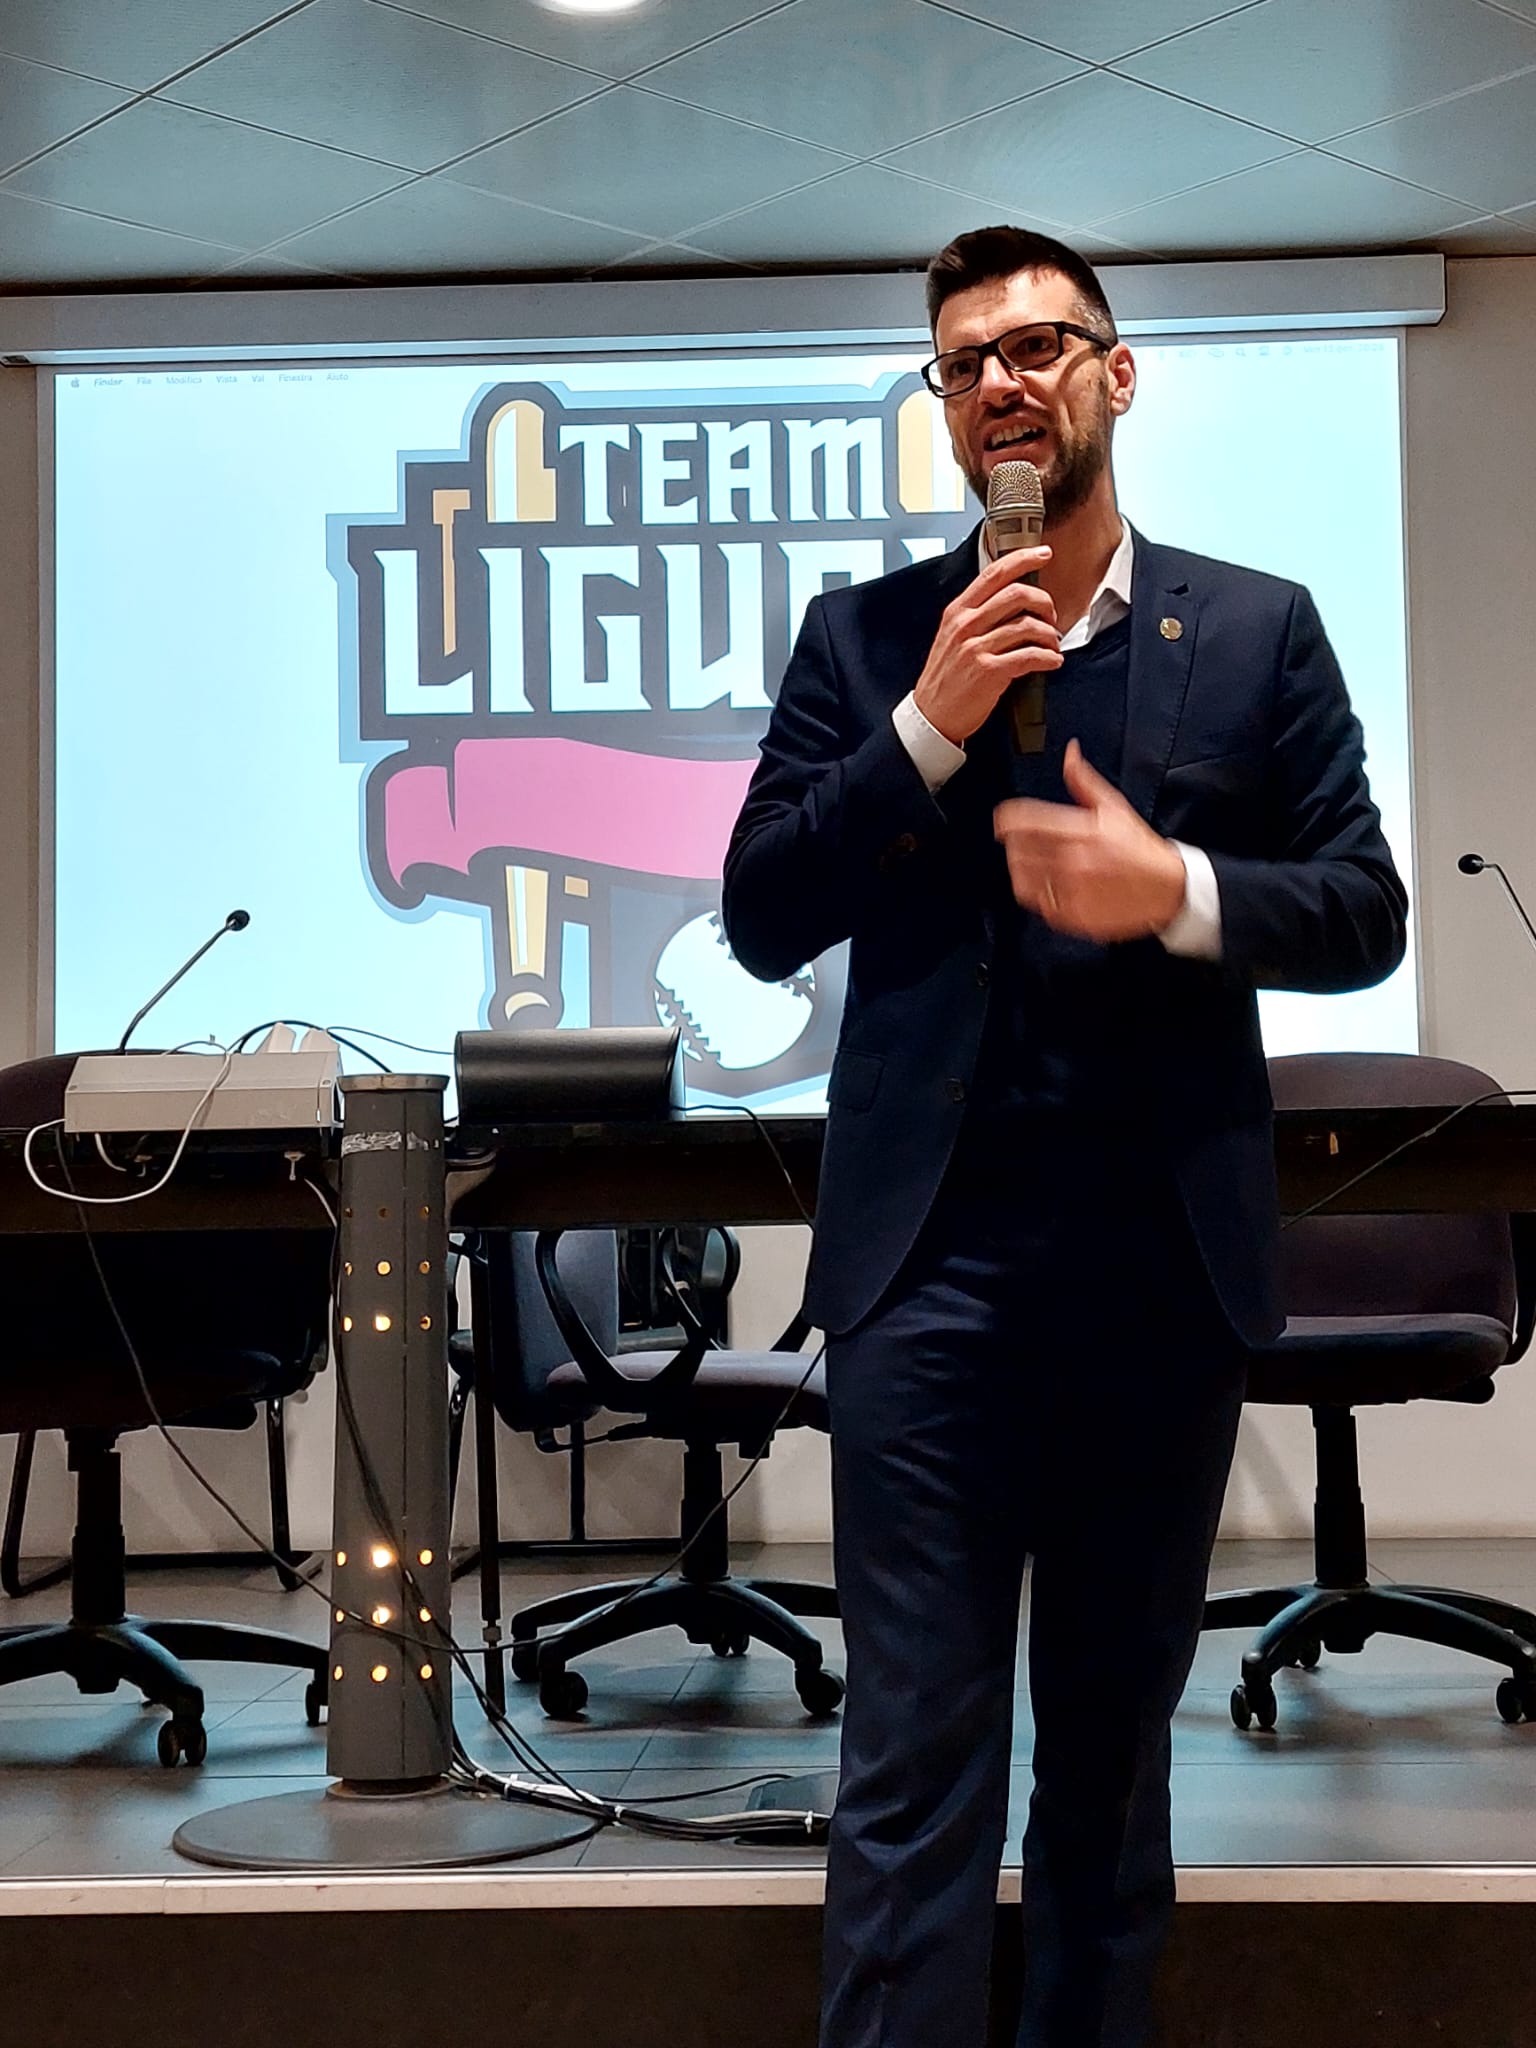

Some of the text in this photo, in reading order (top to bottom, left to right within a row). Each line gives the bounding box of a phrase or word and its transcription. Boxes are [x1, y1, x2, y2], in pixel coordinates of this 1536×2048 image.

[93, 377, 123, 387] Finder
[558, 416, 891, 526] TEAM
[373, 536, 946, 716] LIGU
